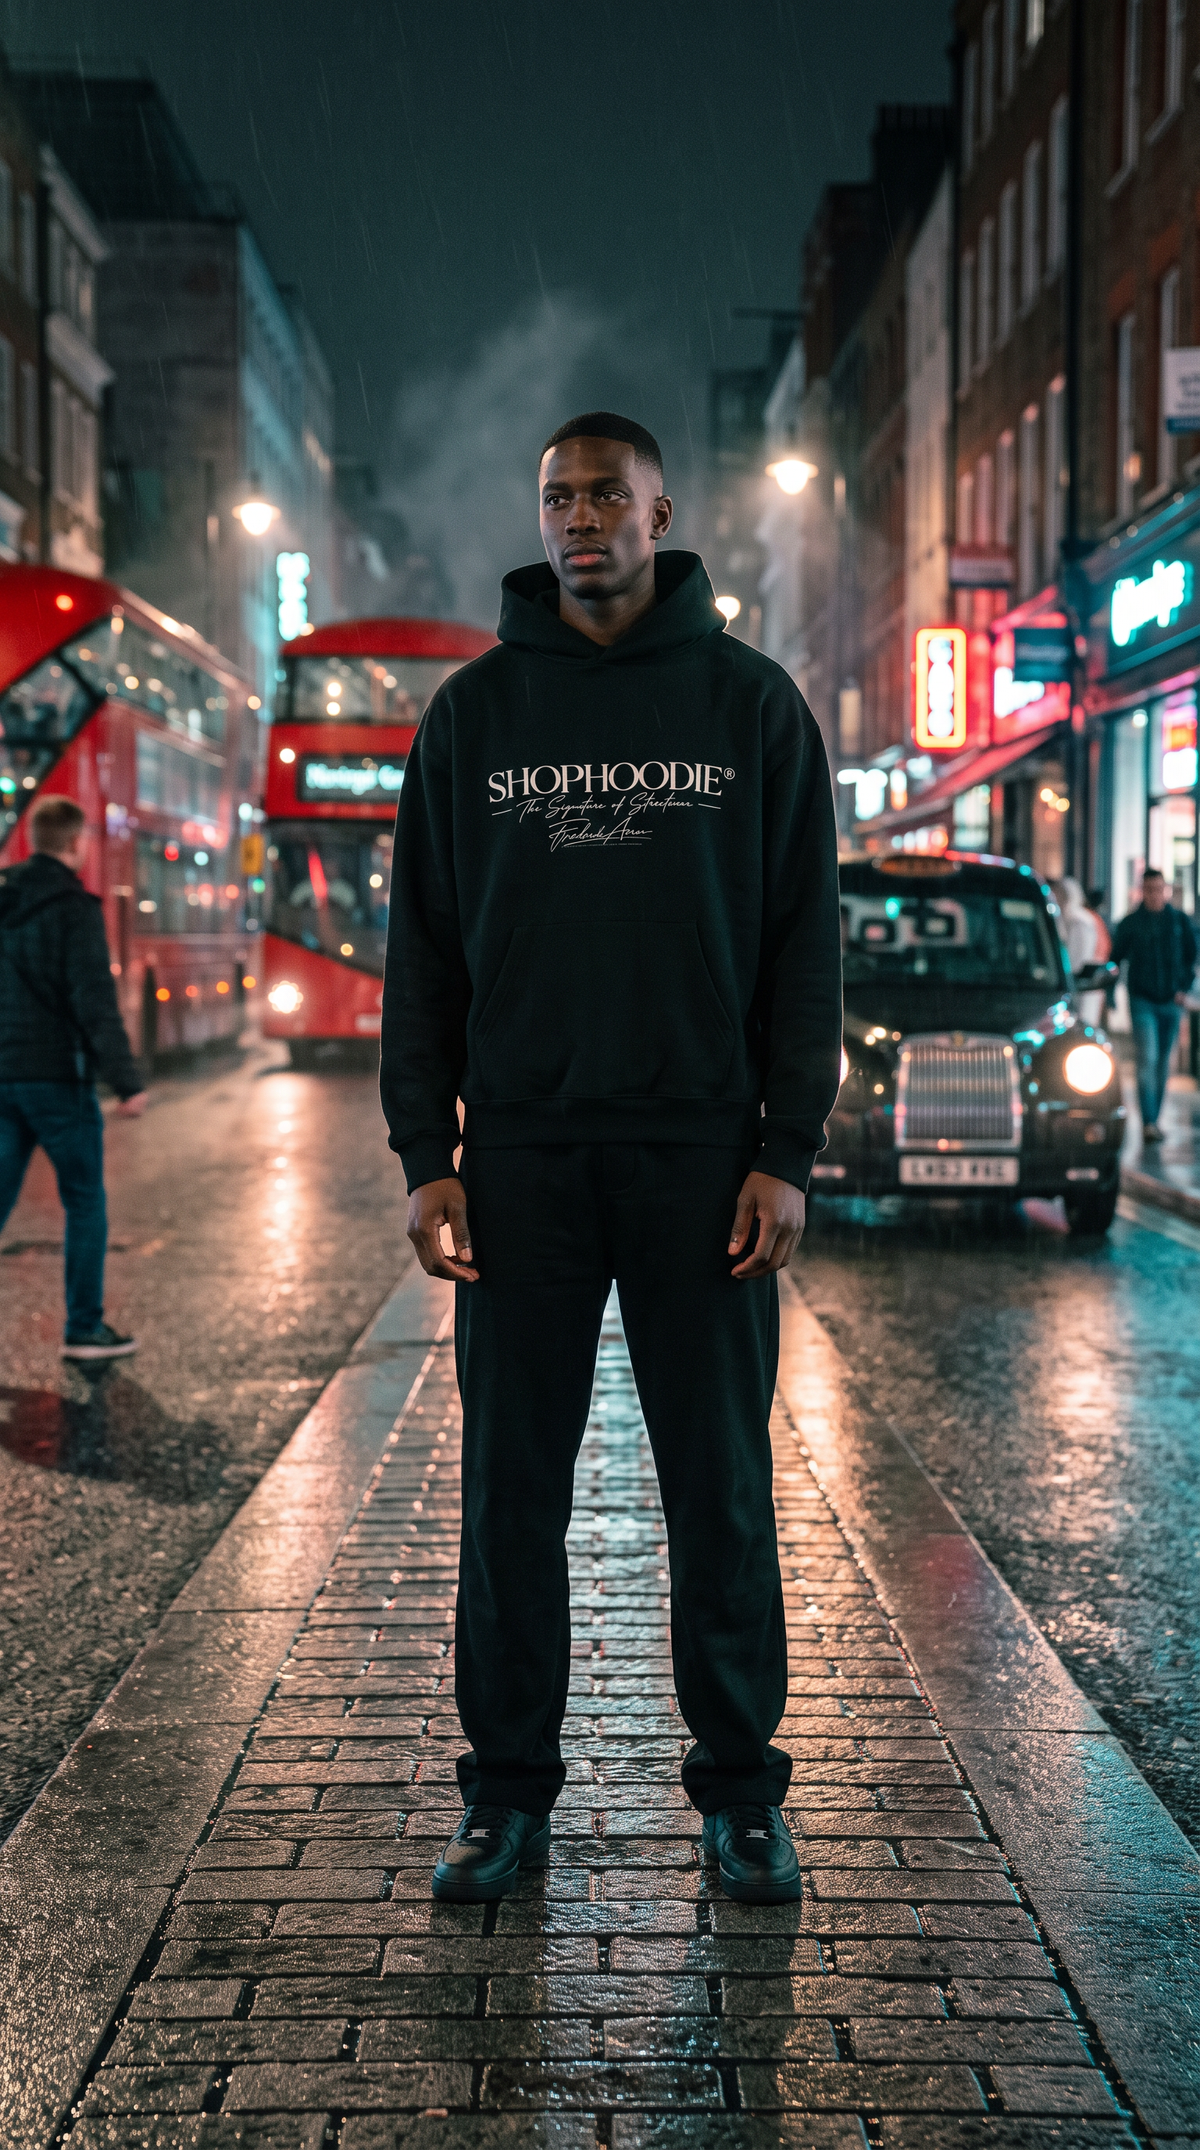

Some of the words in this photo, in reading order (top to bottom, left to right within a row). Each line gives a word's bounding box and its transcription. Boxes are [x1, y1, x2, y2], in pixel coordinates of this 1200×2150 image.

[516, 797, 543, 823] The
[544, 795, 607, 819] Signature
[611, 796, 627, 815] of
[628, 792, 693, 815] Streetwear
